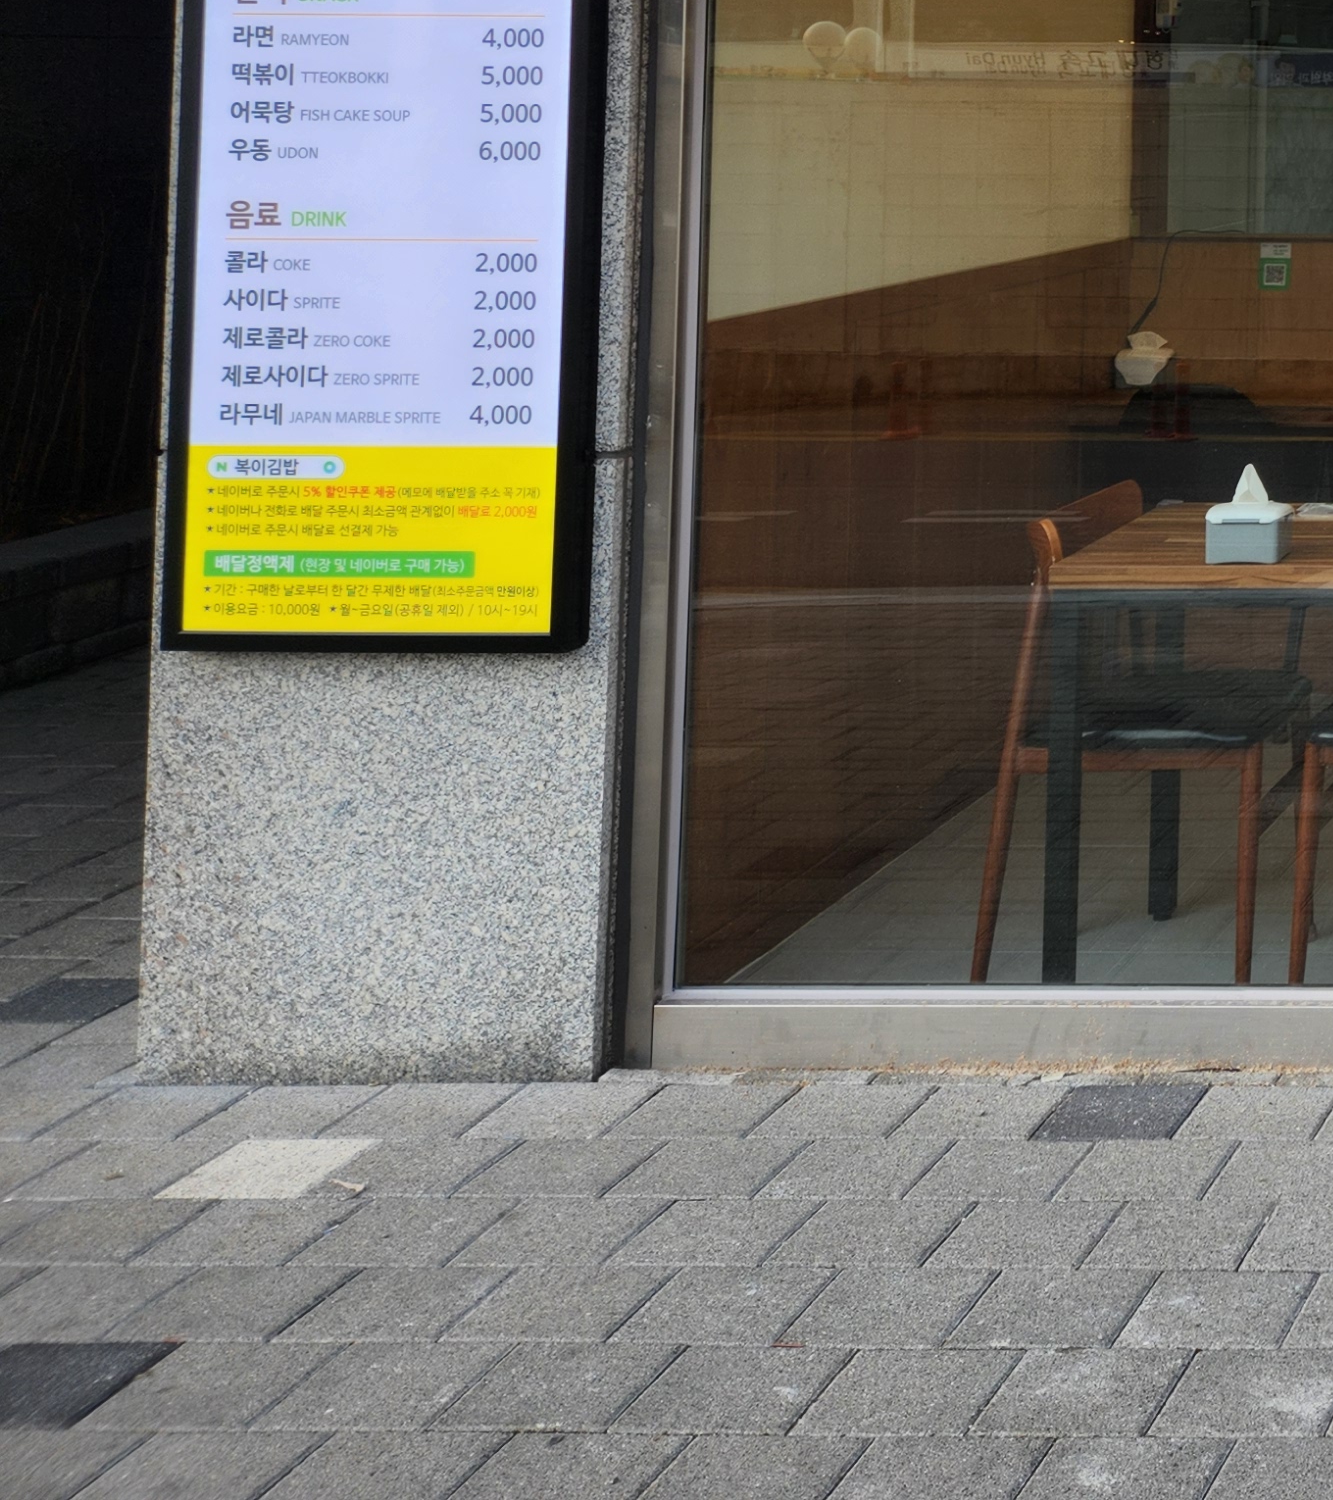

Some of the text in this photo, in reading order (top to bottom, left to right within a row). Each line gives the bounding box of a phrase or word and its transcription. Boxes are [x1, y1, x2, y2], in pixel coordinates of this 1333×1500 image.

[233, 25, 544, 50] 라면 RAMYEON 4,000
[231, 63, 543, 88] 떡볶이 TTEOKBOKKI 5,000
[230, 101, 542, 126] 어묵탕 FISH CAKE SOUP 5,000
[228, 139, 541, 164] 우동 UDON 6,000
[225, 200, 347, 231] 음료 DRINK
[224, 251, 538, 276] 콜라 COKE 2,000
[223, 289, 537, 313] 사이다 SPRITE 2,000
[222, 327, 535, 351] 제로콜라 ZERO COKE 2,000
[221, 365, 534, 389] 제로사이다 ZERO SPRITE 2,000
[219, 403, 532, 427] 라무네 JAPAN MARBLE SPRITE 4,000
[235, 458, 299, 476] 복이김밥
[217, 485, 371, 498] 네이버로 5% 할인쿠폰
[326, 505, 359, 517] 주문시
[216, 524, 298, 536] 네이버로 주문시
[214, 554, 401, 573] 배달정액제 네이버로
